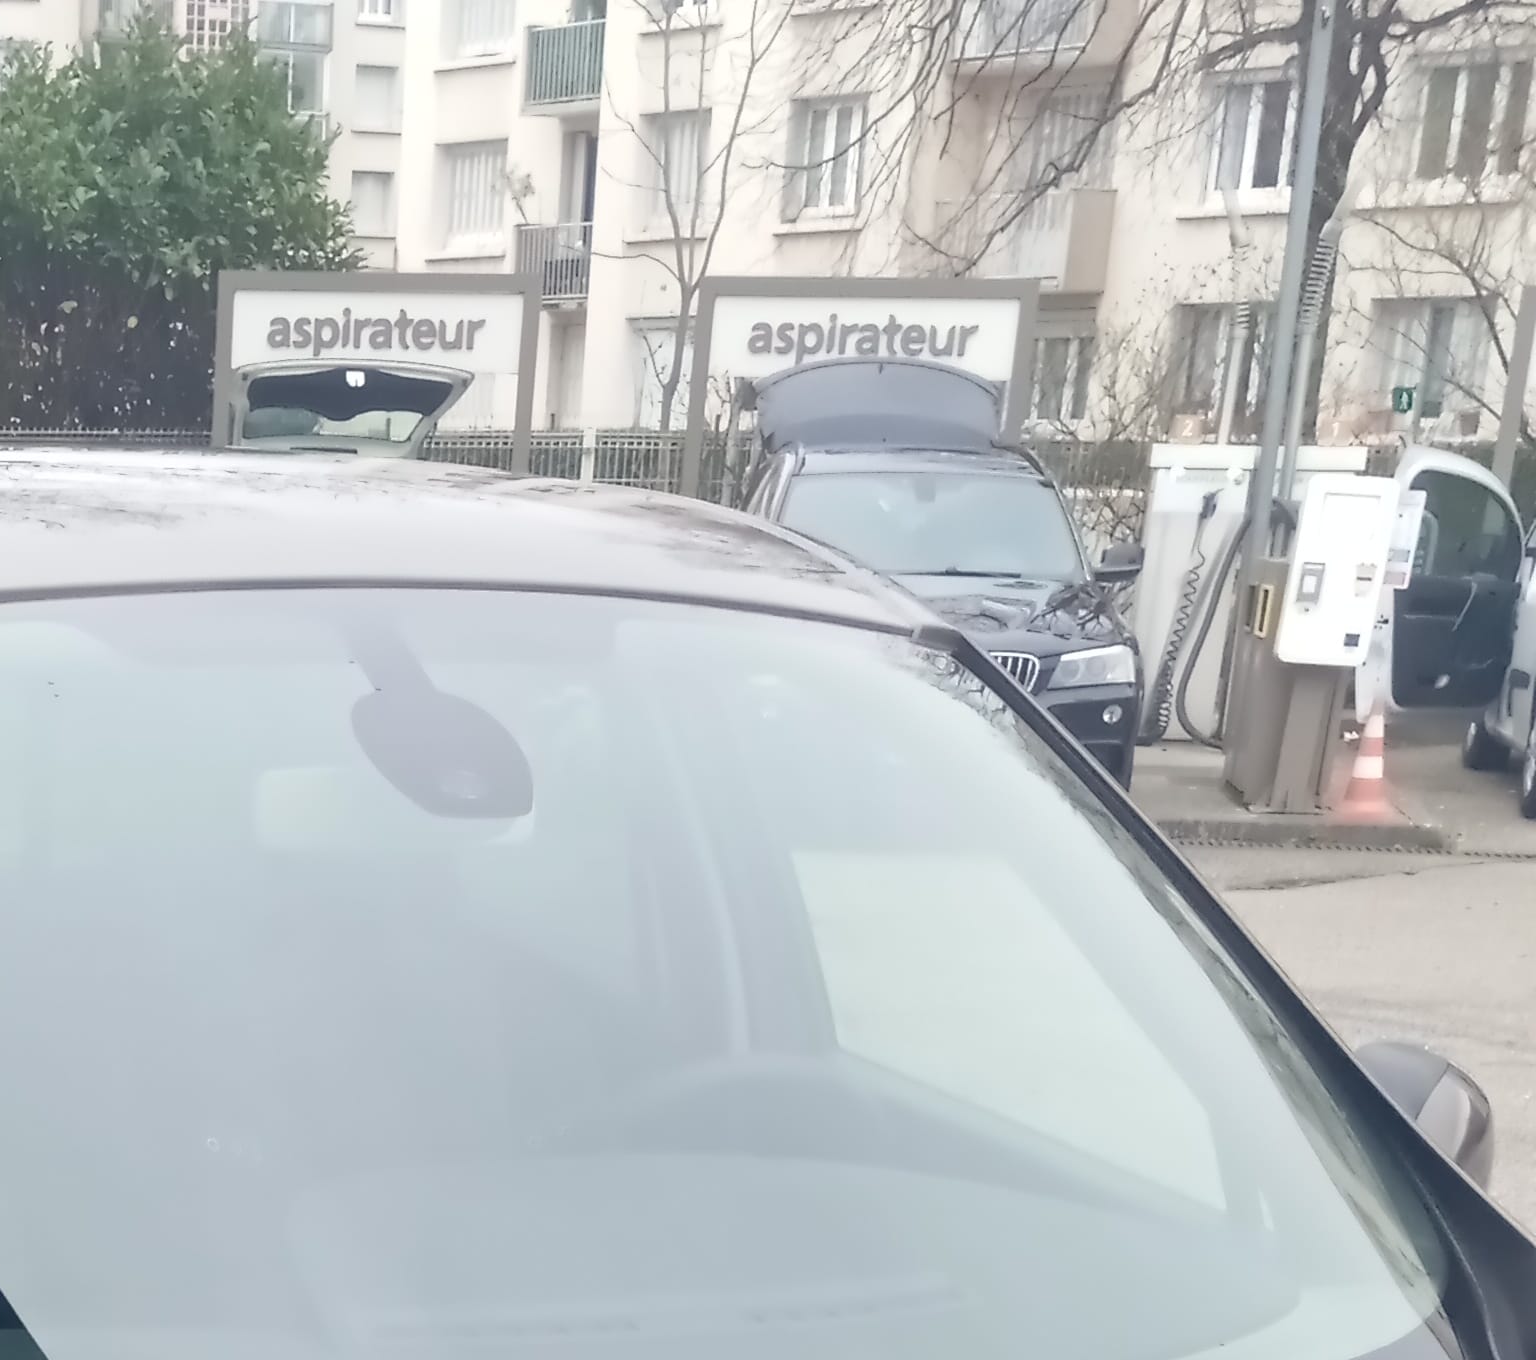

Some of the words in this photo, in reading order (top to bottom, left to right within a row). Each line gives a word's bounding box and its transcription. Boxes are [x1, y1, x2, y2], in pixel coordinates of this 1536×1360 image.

[267, 307, 486, 357] aspirateur
[747, 313, 980, 366] aspirateur
[1180, 419, 1194, 437] 2
[1331, 421, 1340, 438] 1
